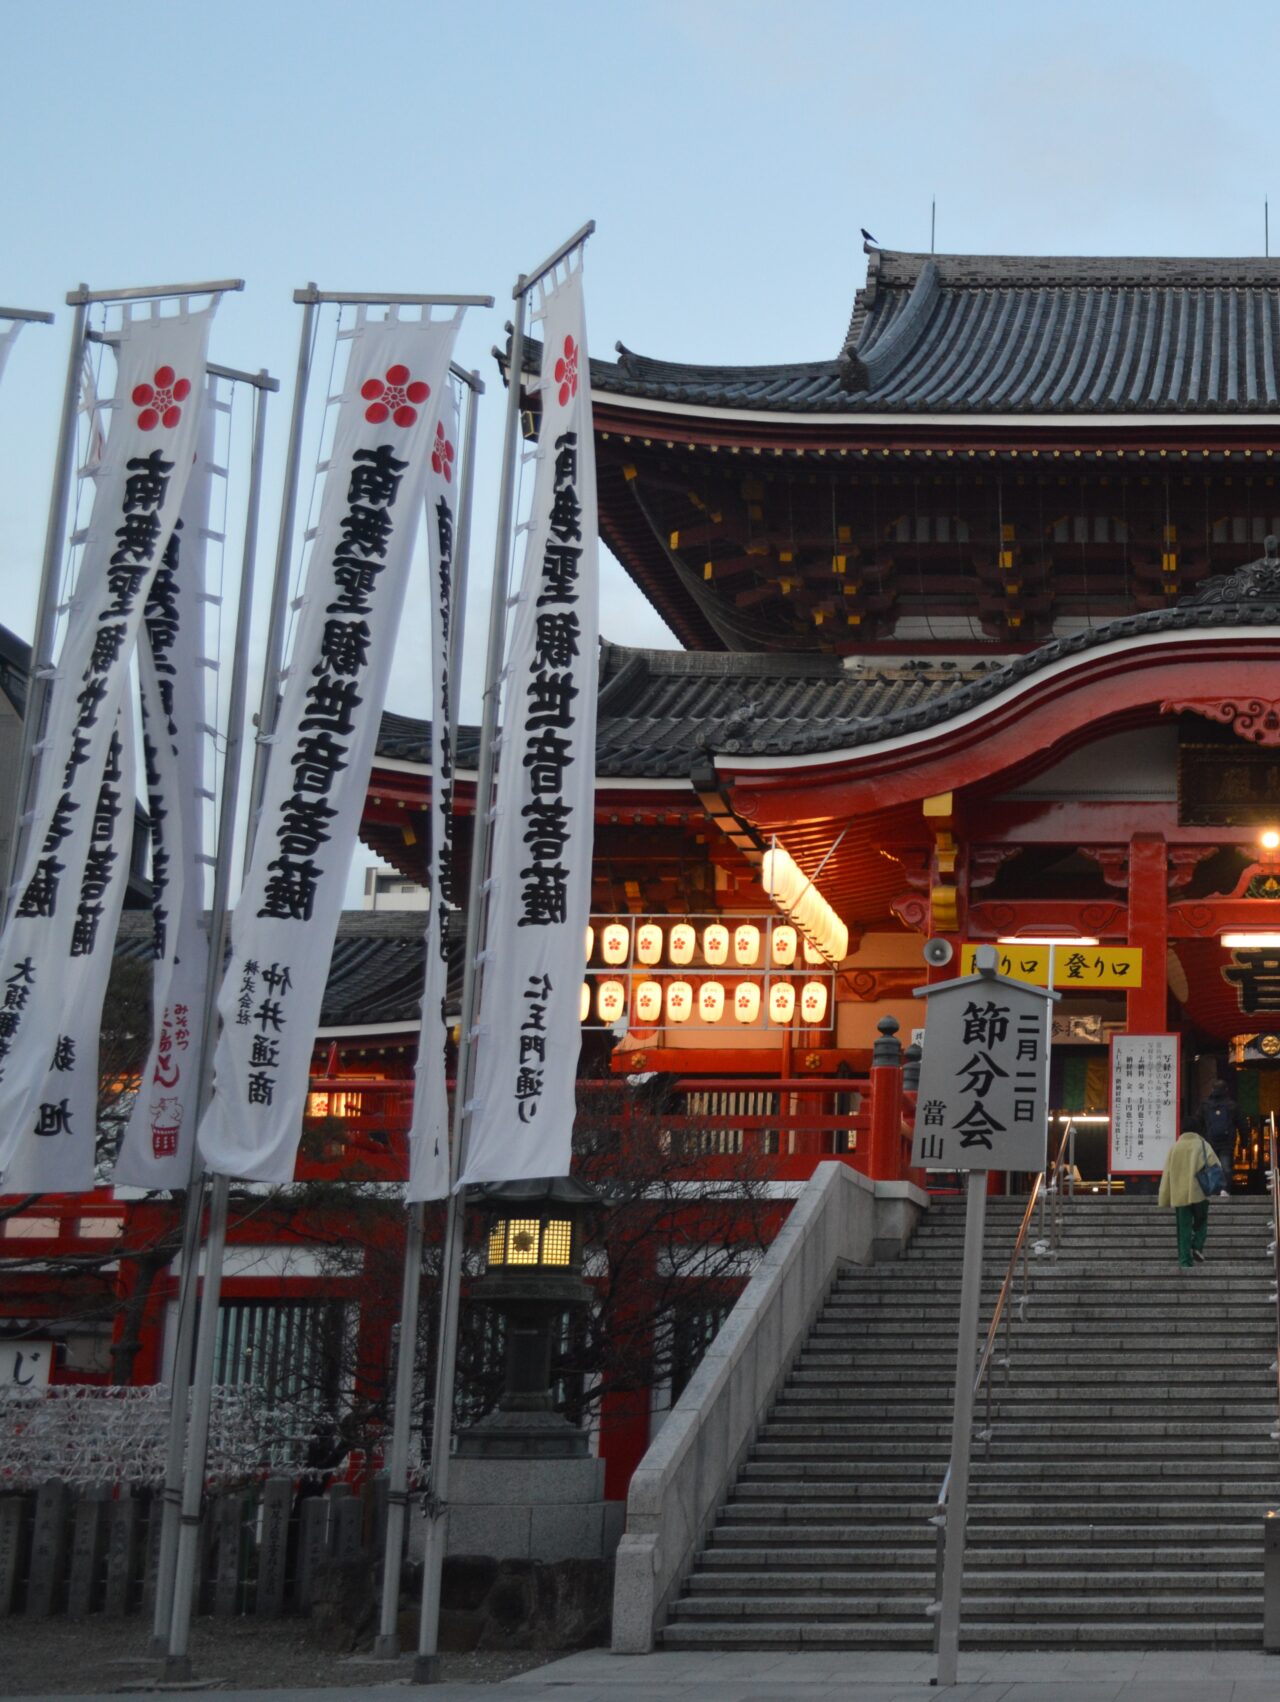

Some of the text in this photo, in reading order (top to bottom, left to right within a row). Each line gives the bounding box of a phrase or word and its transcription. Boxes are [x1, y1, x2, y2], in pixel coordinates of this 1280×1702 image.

[970, 953, 1038, 977] り口
[1063, 953, 1131, 979] 登り口
[152, 1007, 180, 1088] 場とん
[174, 1003, 190, 1050] みそかつ
[952, 1001, 1011, 1151] 節分会
[1013, 1013, 1041, 1123] 二月二日
[1163, 1054, 1172, 1106] 写経のすすめ
[920, 1099, 947, 1160] 當山
[13, 1351, 41, 1385] じ
